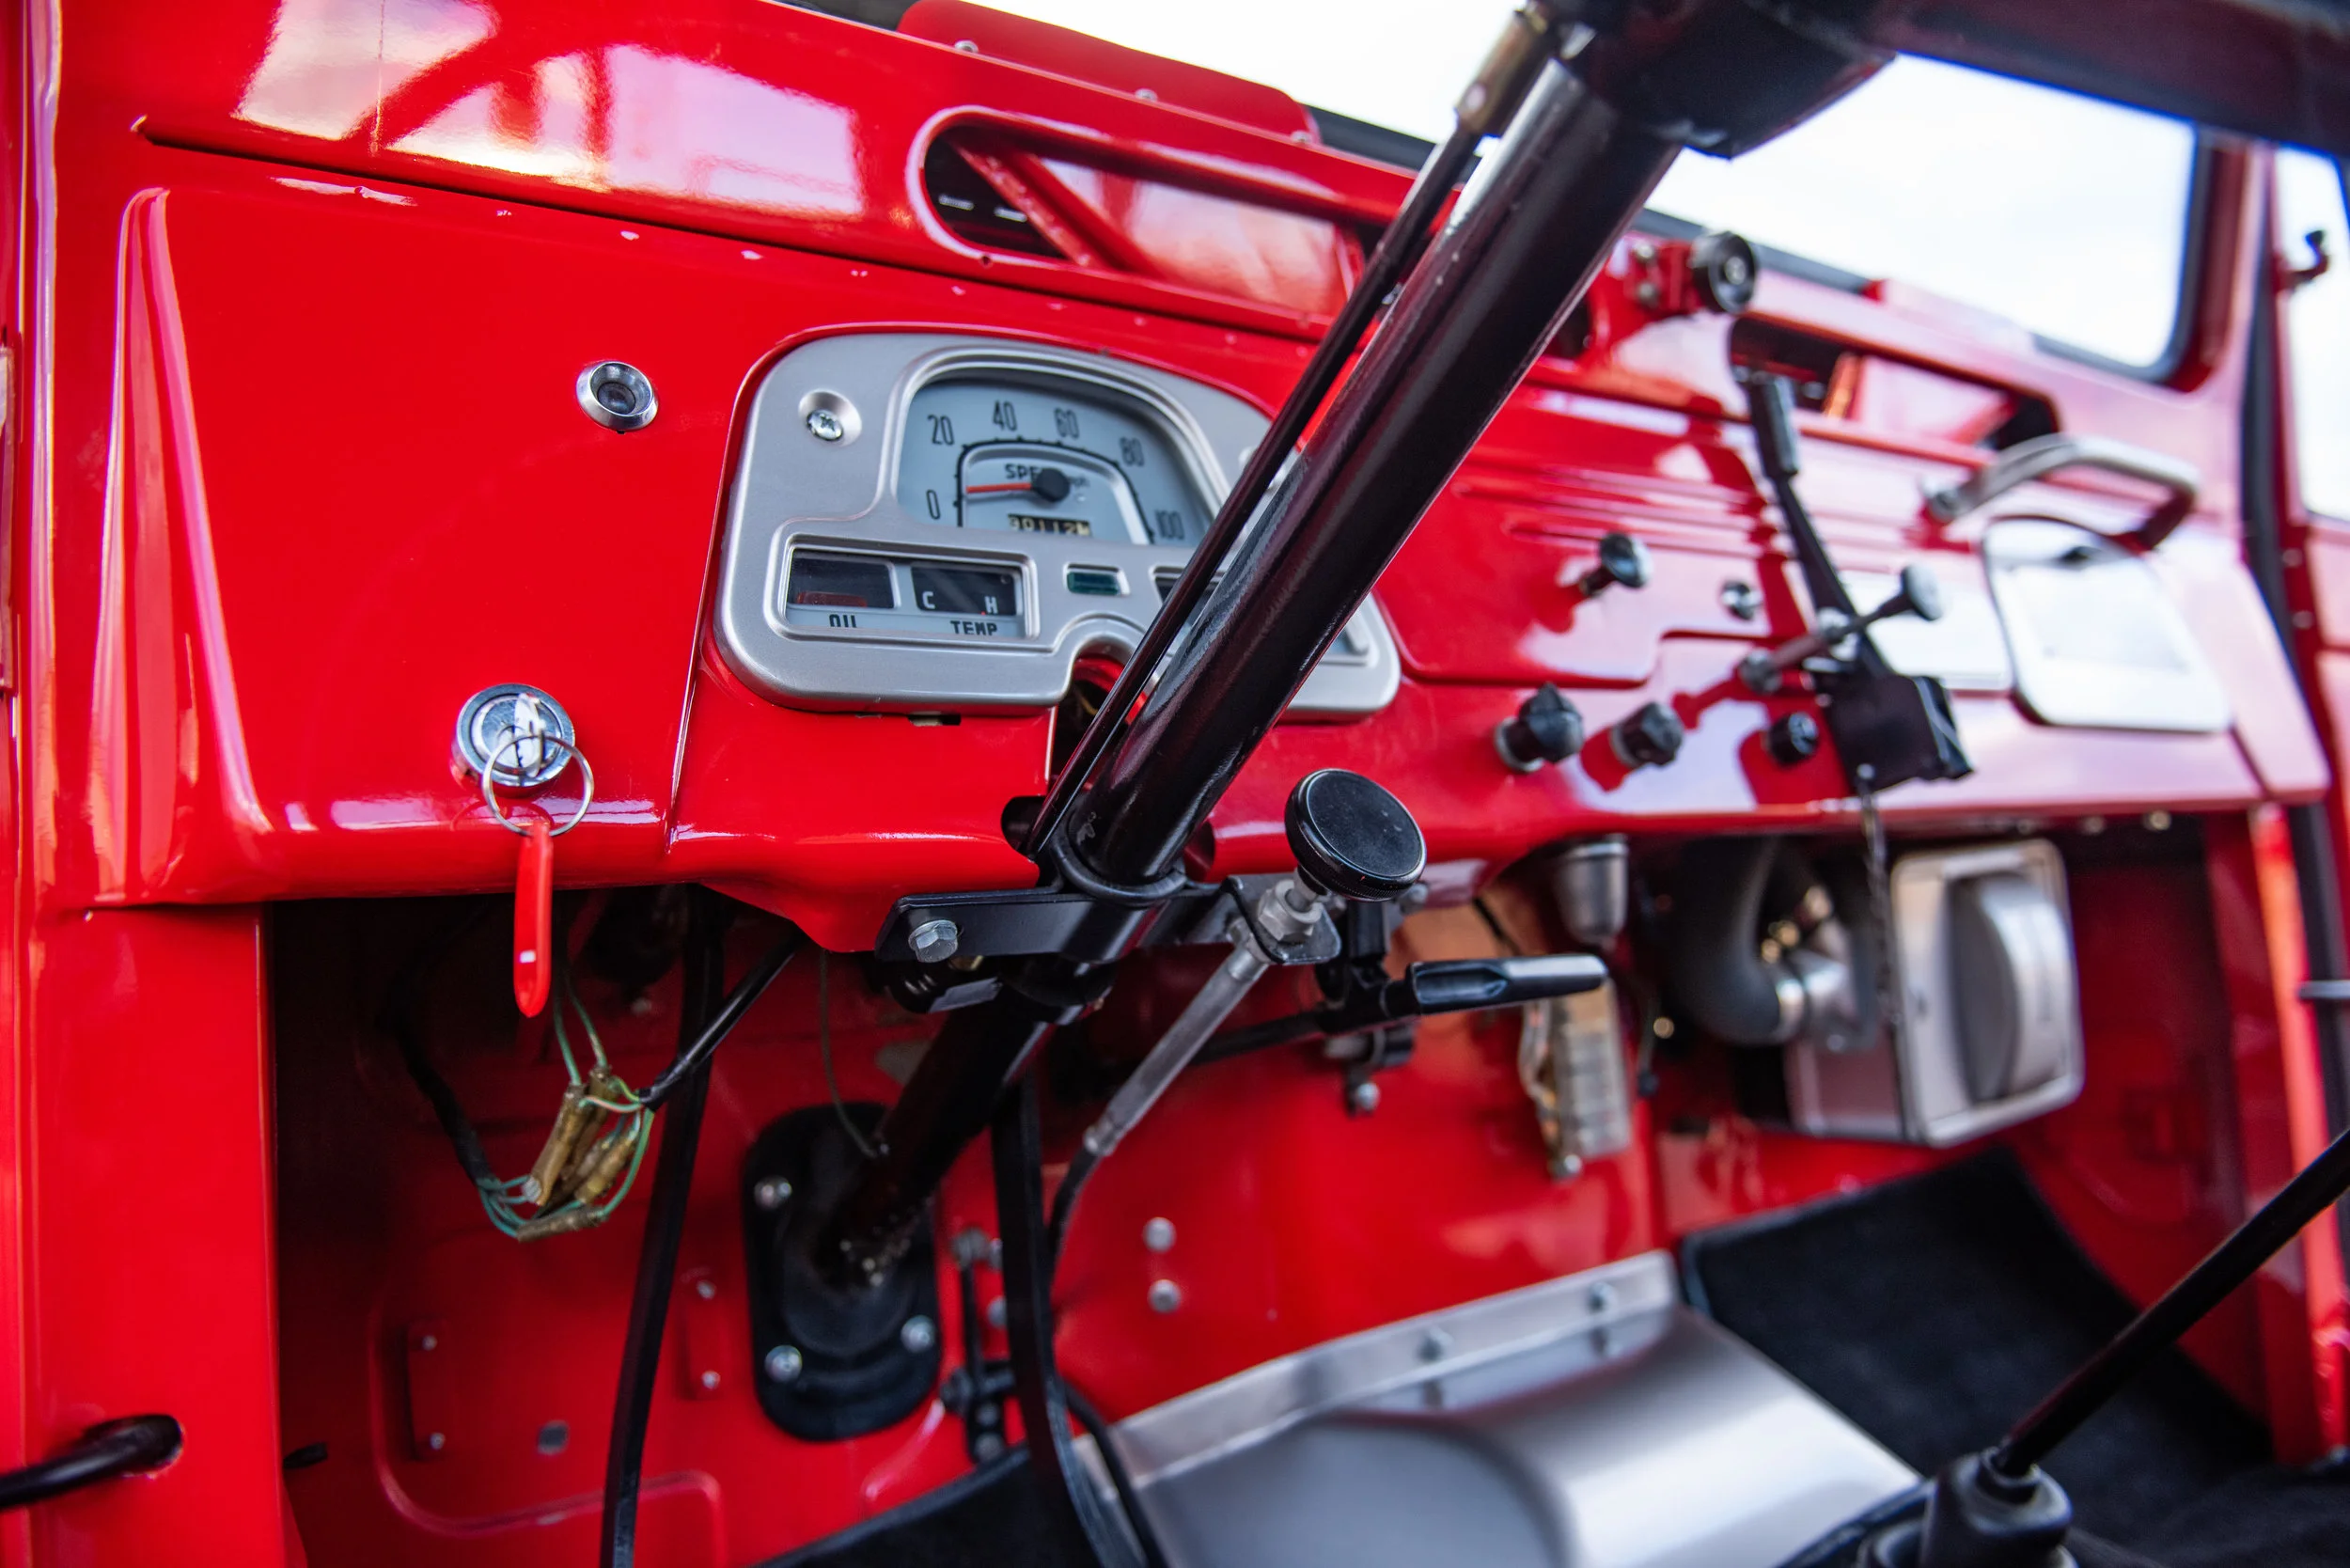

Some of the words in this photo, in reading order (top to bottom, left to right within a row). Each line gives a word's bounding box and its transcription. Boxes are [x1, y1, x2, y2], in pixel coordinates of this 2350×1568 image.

[927, 414, 954, 446] 20
[993, 400, 1017, 431] 40
[1054, 407, 1080, 439] 60
[1120, 436, 1145, 467] 80
[926, 489, 941, 520] 0
[922, 590, 935, 609] C
[984, 595, 998, 614] H
[949, 620, 998, 635] TEMP
